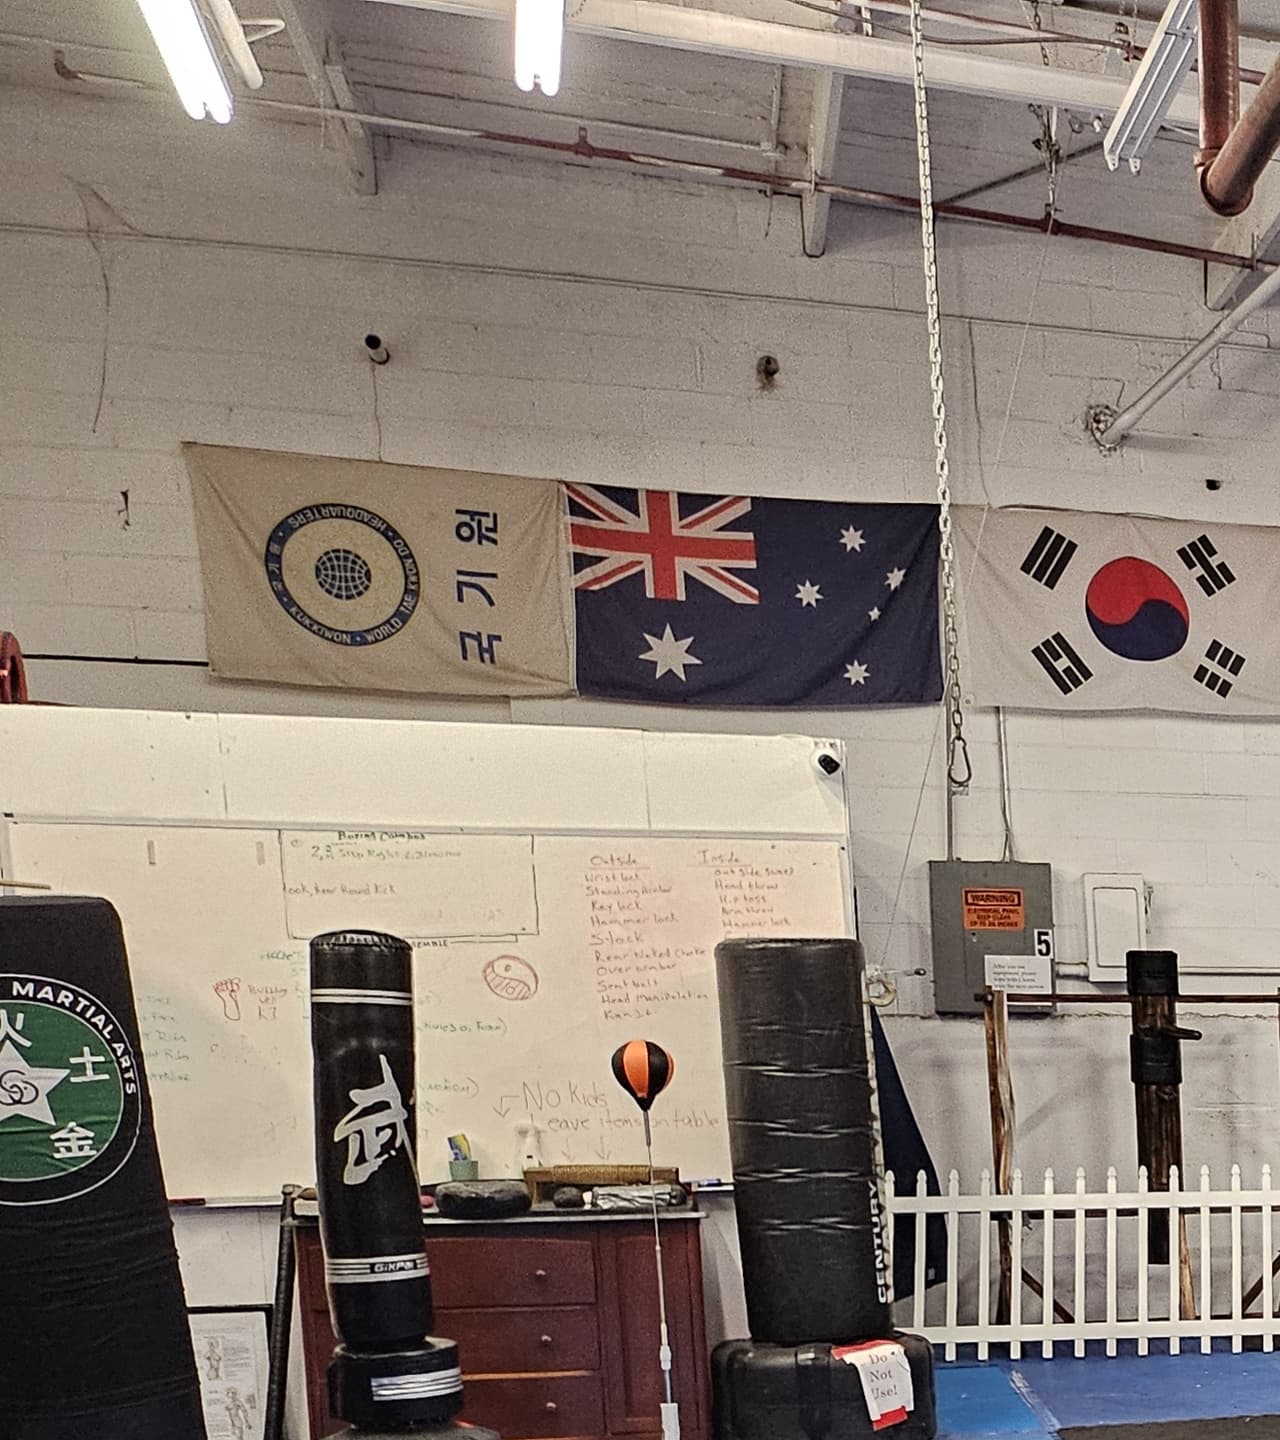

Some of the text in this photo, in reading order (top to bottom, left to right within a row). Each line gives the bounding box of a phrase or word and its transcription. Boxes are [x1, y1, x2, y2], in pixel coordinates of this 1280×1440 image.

[289, 505, 387, 532] HEADQUARTERS
[365, 538, 418, 643] WORLD TAE KWON DO
[289, 606, 351, 645] KUKKIWON
[697, 850, 740, 865] Inside
[590, 911, 680, 927] Hammer lock
[1037, 931, 1051, 957] 5
[12, 980, 137, 1095] MARTIAL ARTS
[522, 1079, 608, 1111] No Kids
[599, 1109, 643, 1128] items
[672, 1111, 720, 1129] table
[50, 1121, 97, 1159] 金
[868, 1181, 887, 1304] CENTURY
[868, 1352, 889, 1364] Do
[869, 1369, 894, 1383] Not
[871, 1385, 899, 1401] Use!
